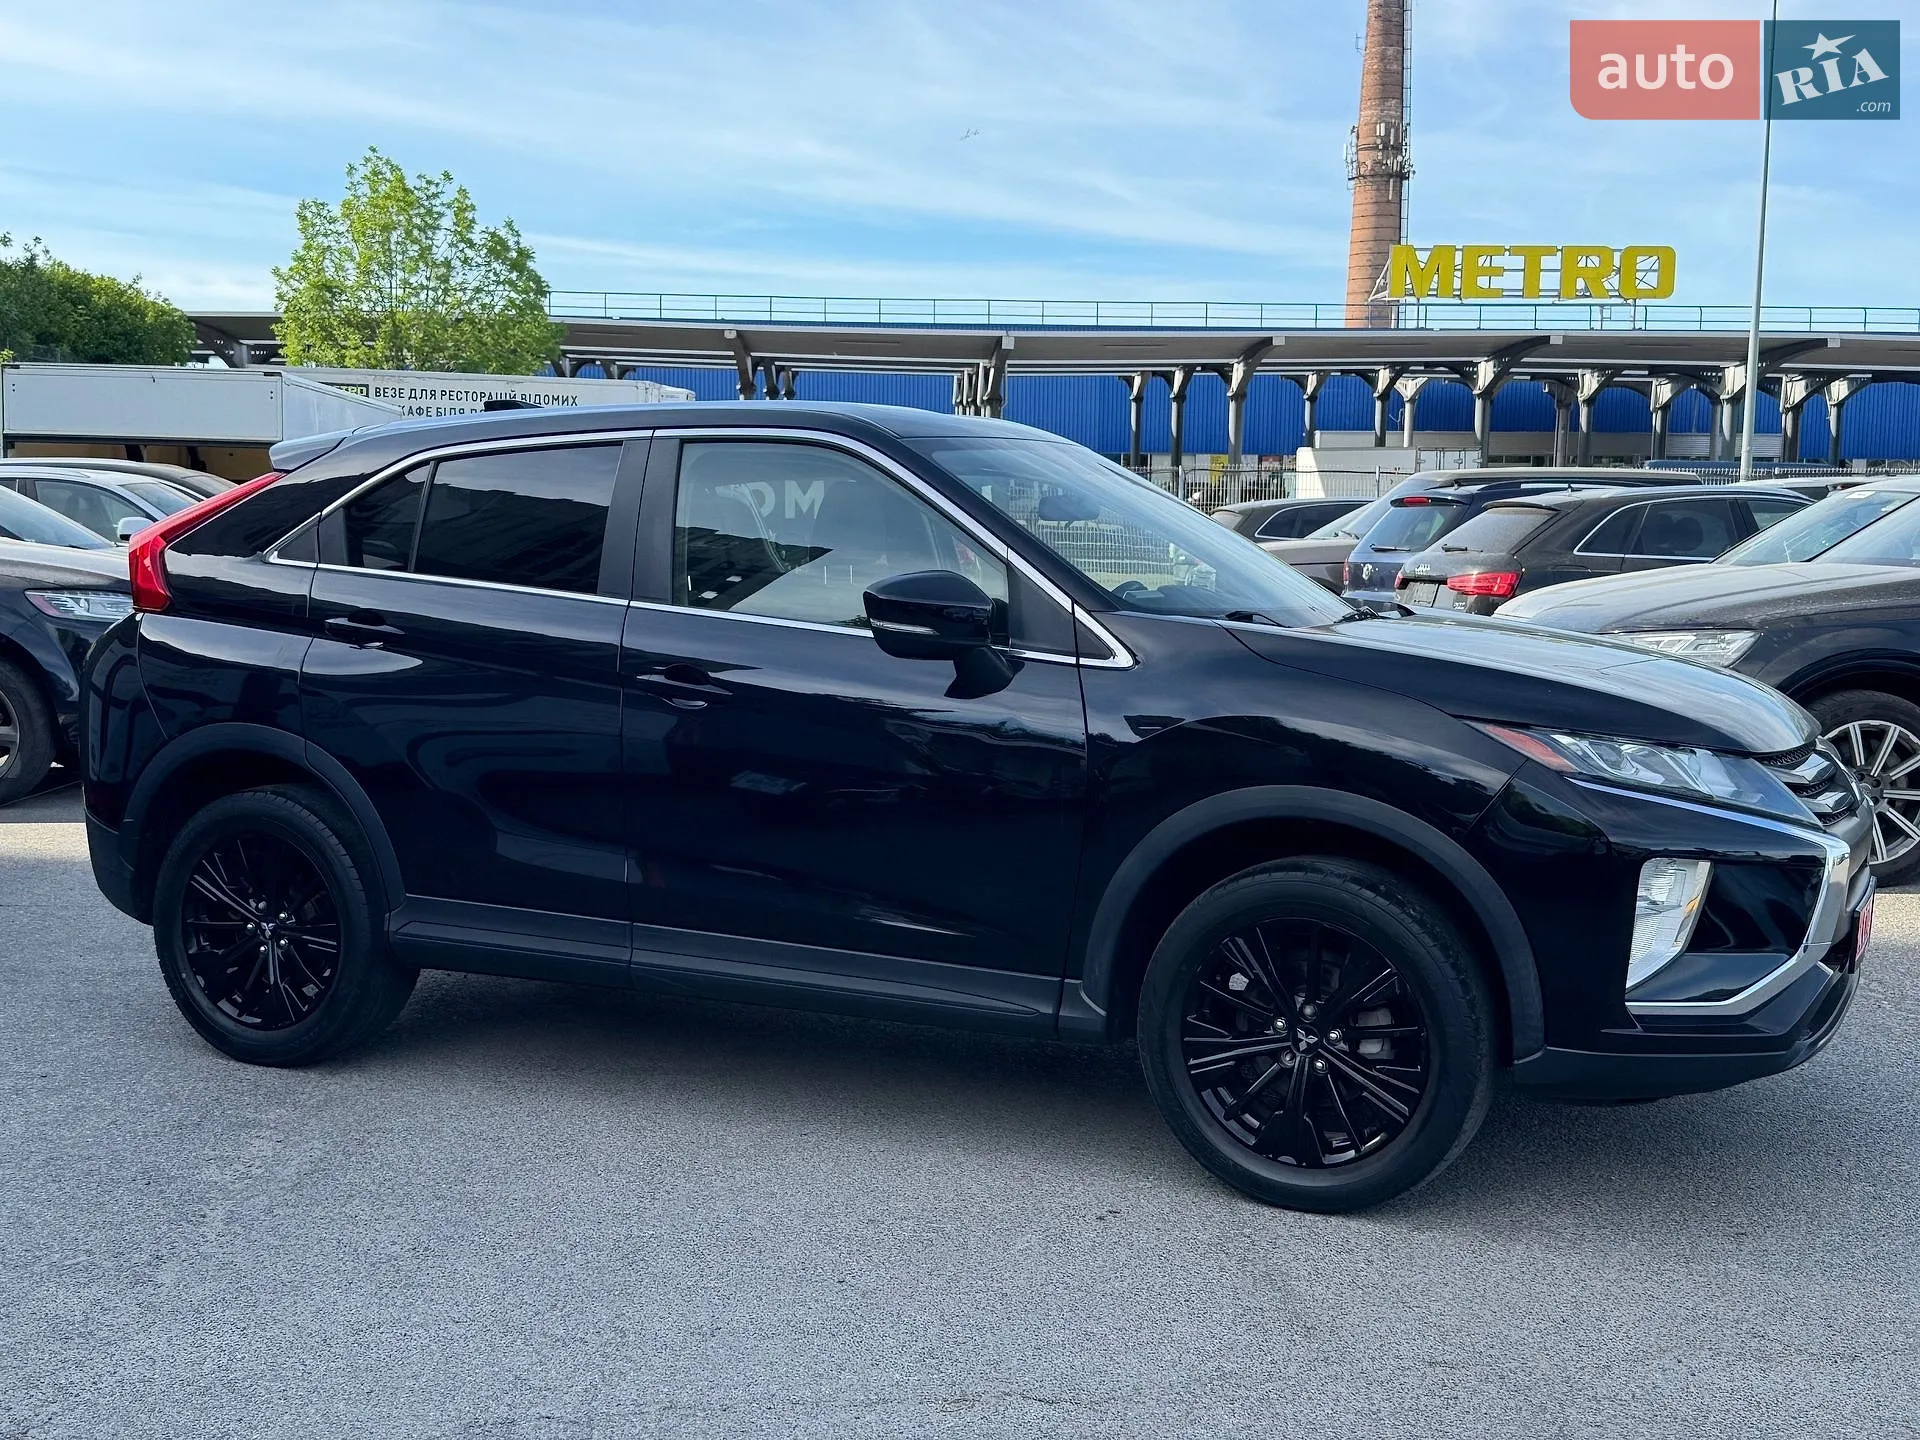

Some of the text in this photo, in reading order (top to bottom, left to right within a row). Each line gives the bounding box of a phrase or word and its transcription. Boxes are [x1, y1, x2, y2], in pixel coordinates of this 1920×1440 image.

[1388, 245, 1676, 299] METRO
[374, 387, 405, 398] ВЕЗЕ
[408, 388, 437, 400] ДЛЯ
[520, 393, 578, 406] ВІДОМИХ
